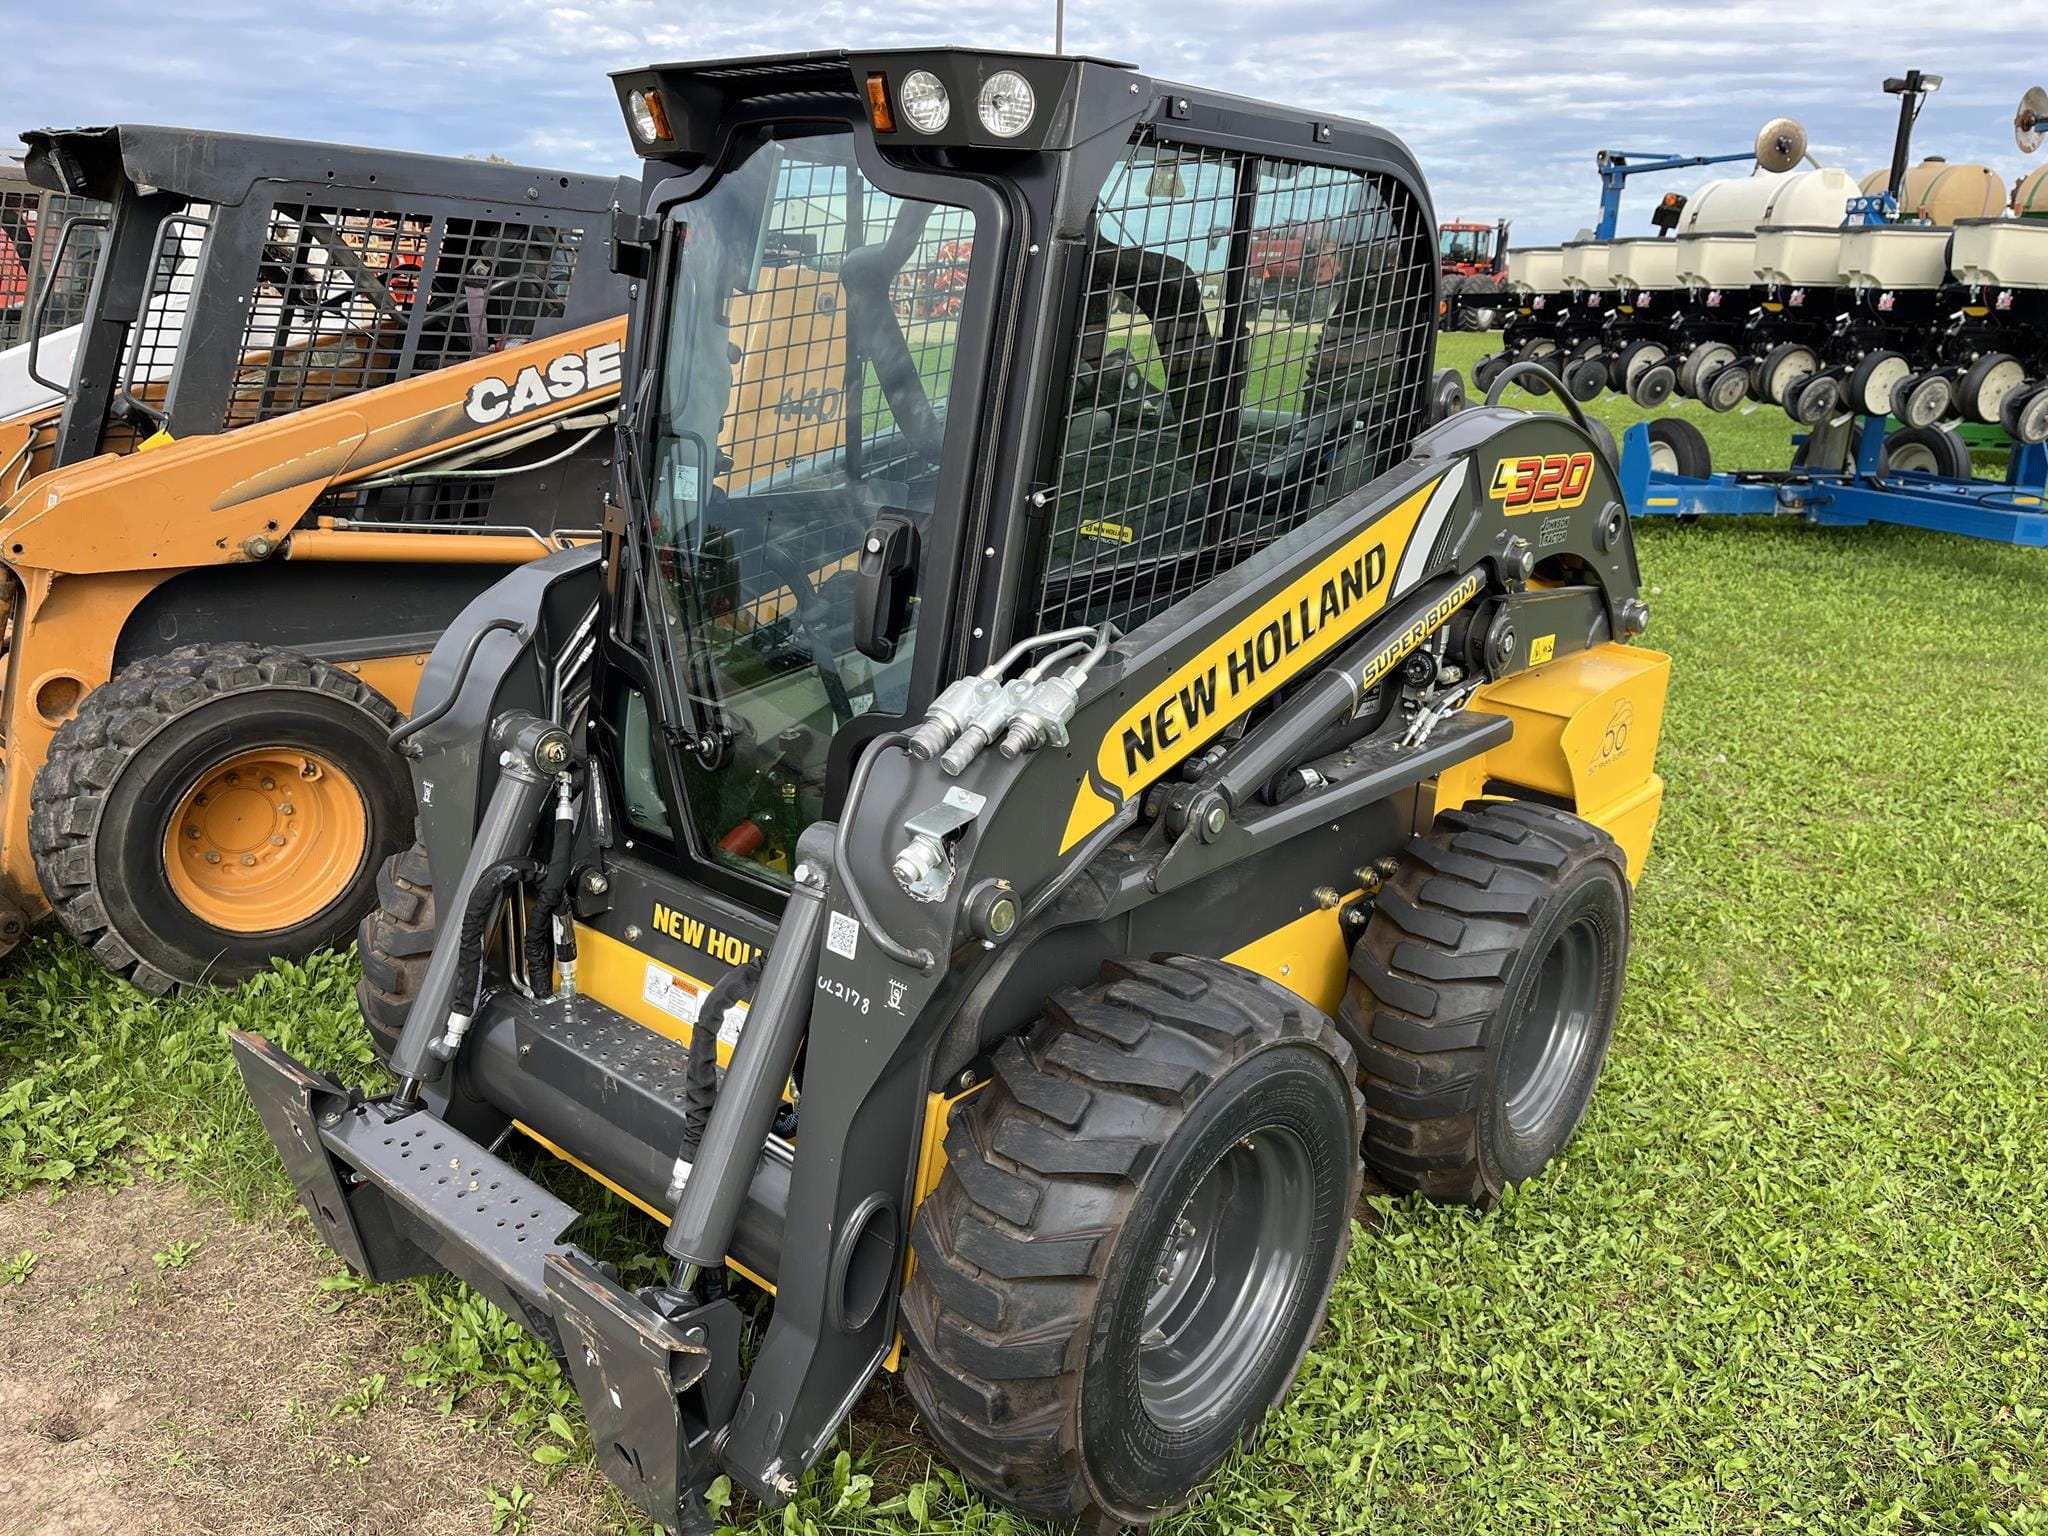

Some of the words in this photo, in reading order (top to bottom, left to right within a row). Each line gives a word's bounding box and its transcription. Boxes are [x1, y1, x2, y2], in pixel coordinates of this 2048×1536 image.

[465, 340, 623, 424] CASE
[774, 386, 841, 423] 440
[1491, 454, 1593, 512] L320
[1121, 664, 1217, 778] NEW
[1226, 541, 1387, 697] HOLLAND
[1364, 621, 1427, 688] SUPER
[1426, 576, 1476, 633] BOOM
[653, 902, 705, 949] NEW
